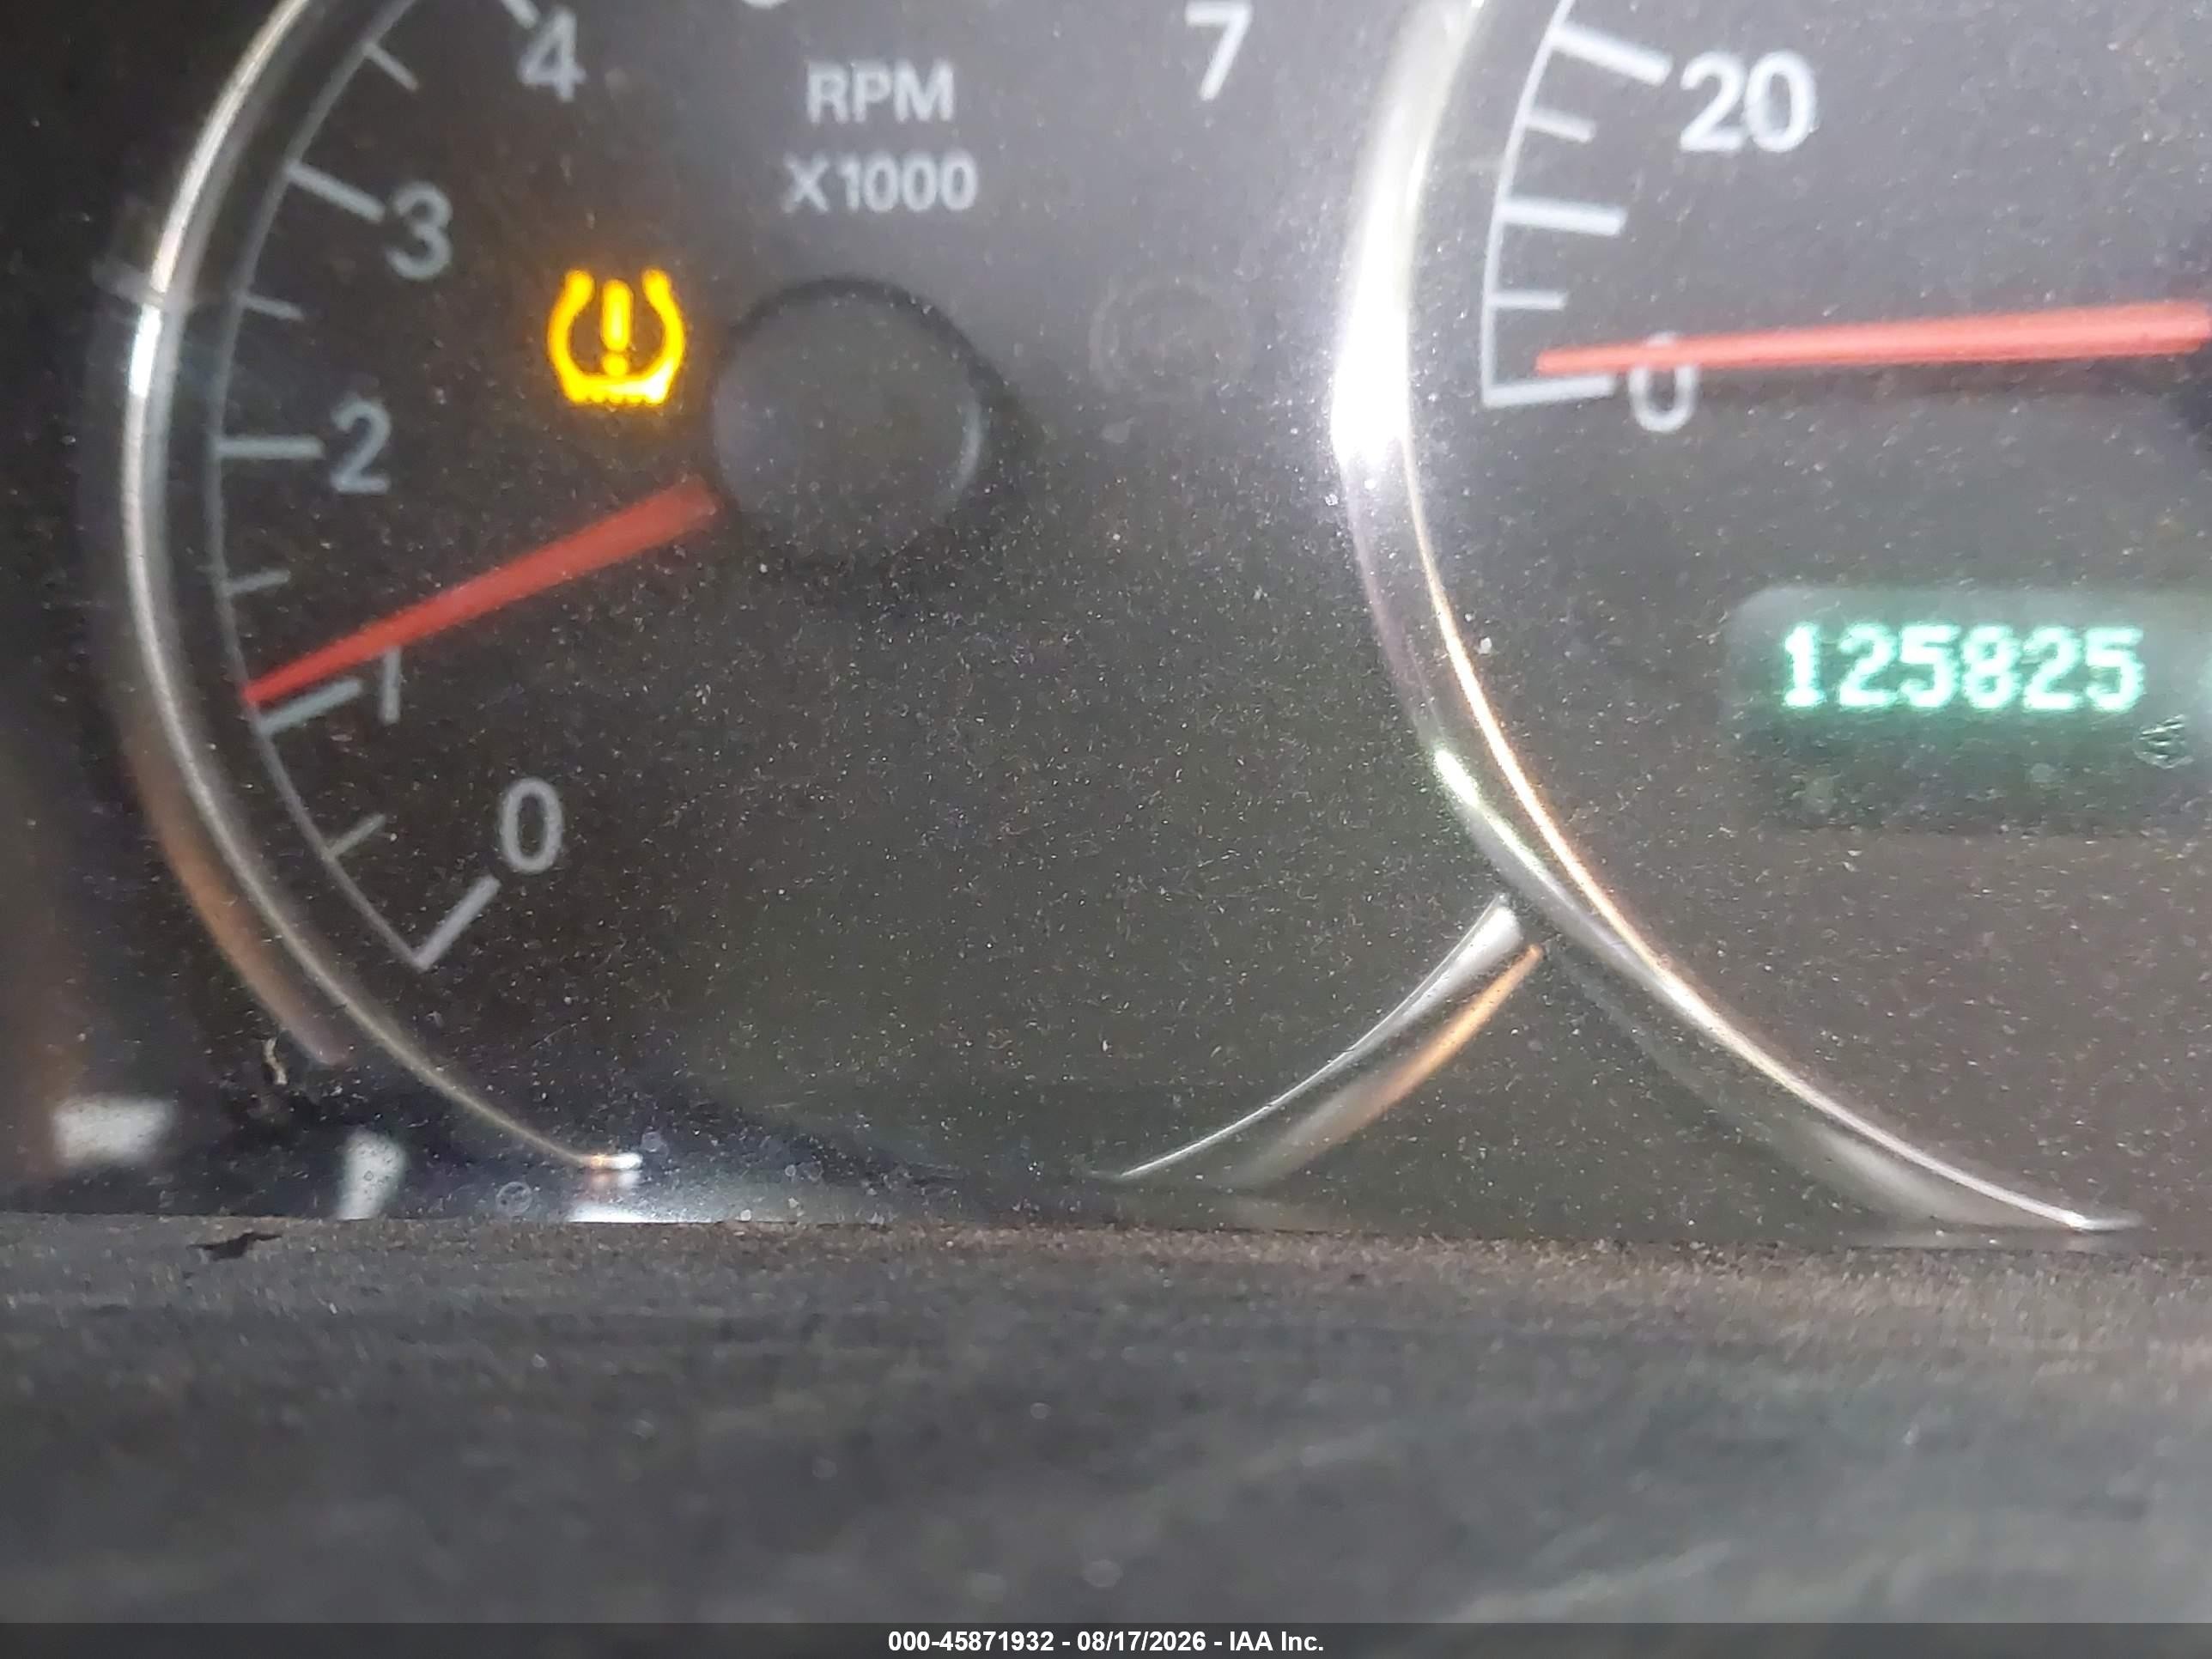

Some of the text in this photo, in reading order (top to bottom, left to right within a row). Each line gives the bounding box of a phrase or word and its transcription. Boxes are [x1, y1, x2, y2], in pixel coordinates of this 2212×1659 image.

[519, 8, 586, 102] 4
[805, 61, 955, 123] RPM
[1185, 0, 1252, 101] 7
[1680, 52, 1816, 153] 20
[385, 182, 452, 280] 3
[786, 154, 977, 213] X1000
[1627, 333, 1698, 432] 0
[329, 400, 392, 494] 2
[1784, 623, 2145, 712] 125825
[499, 778, 563, 874] 0
